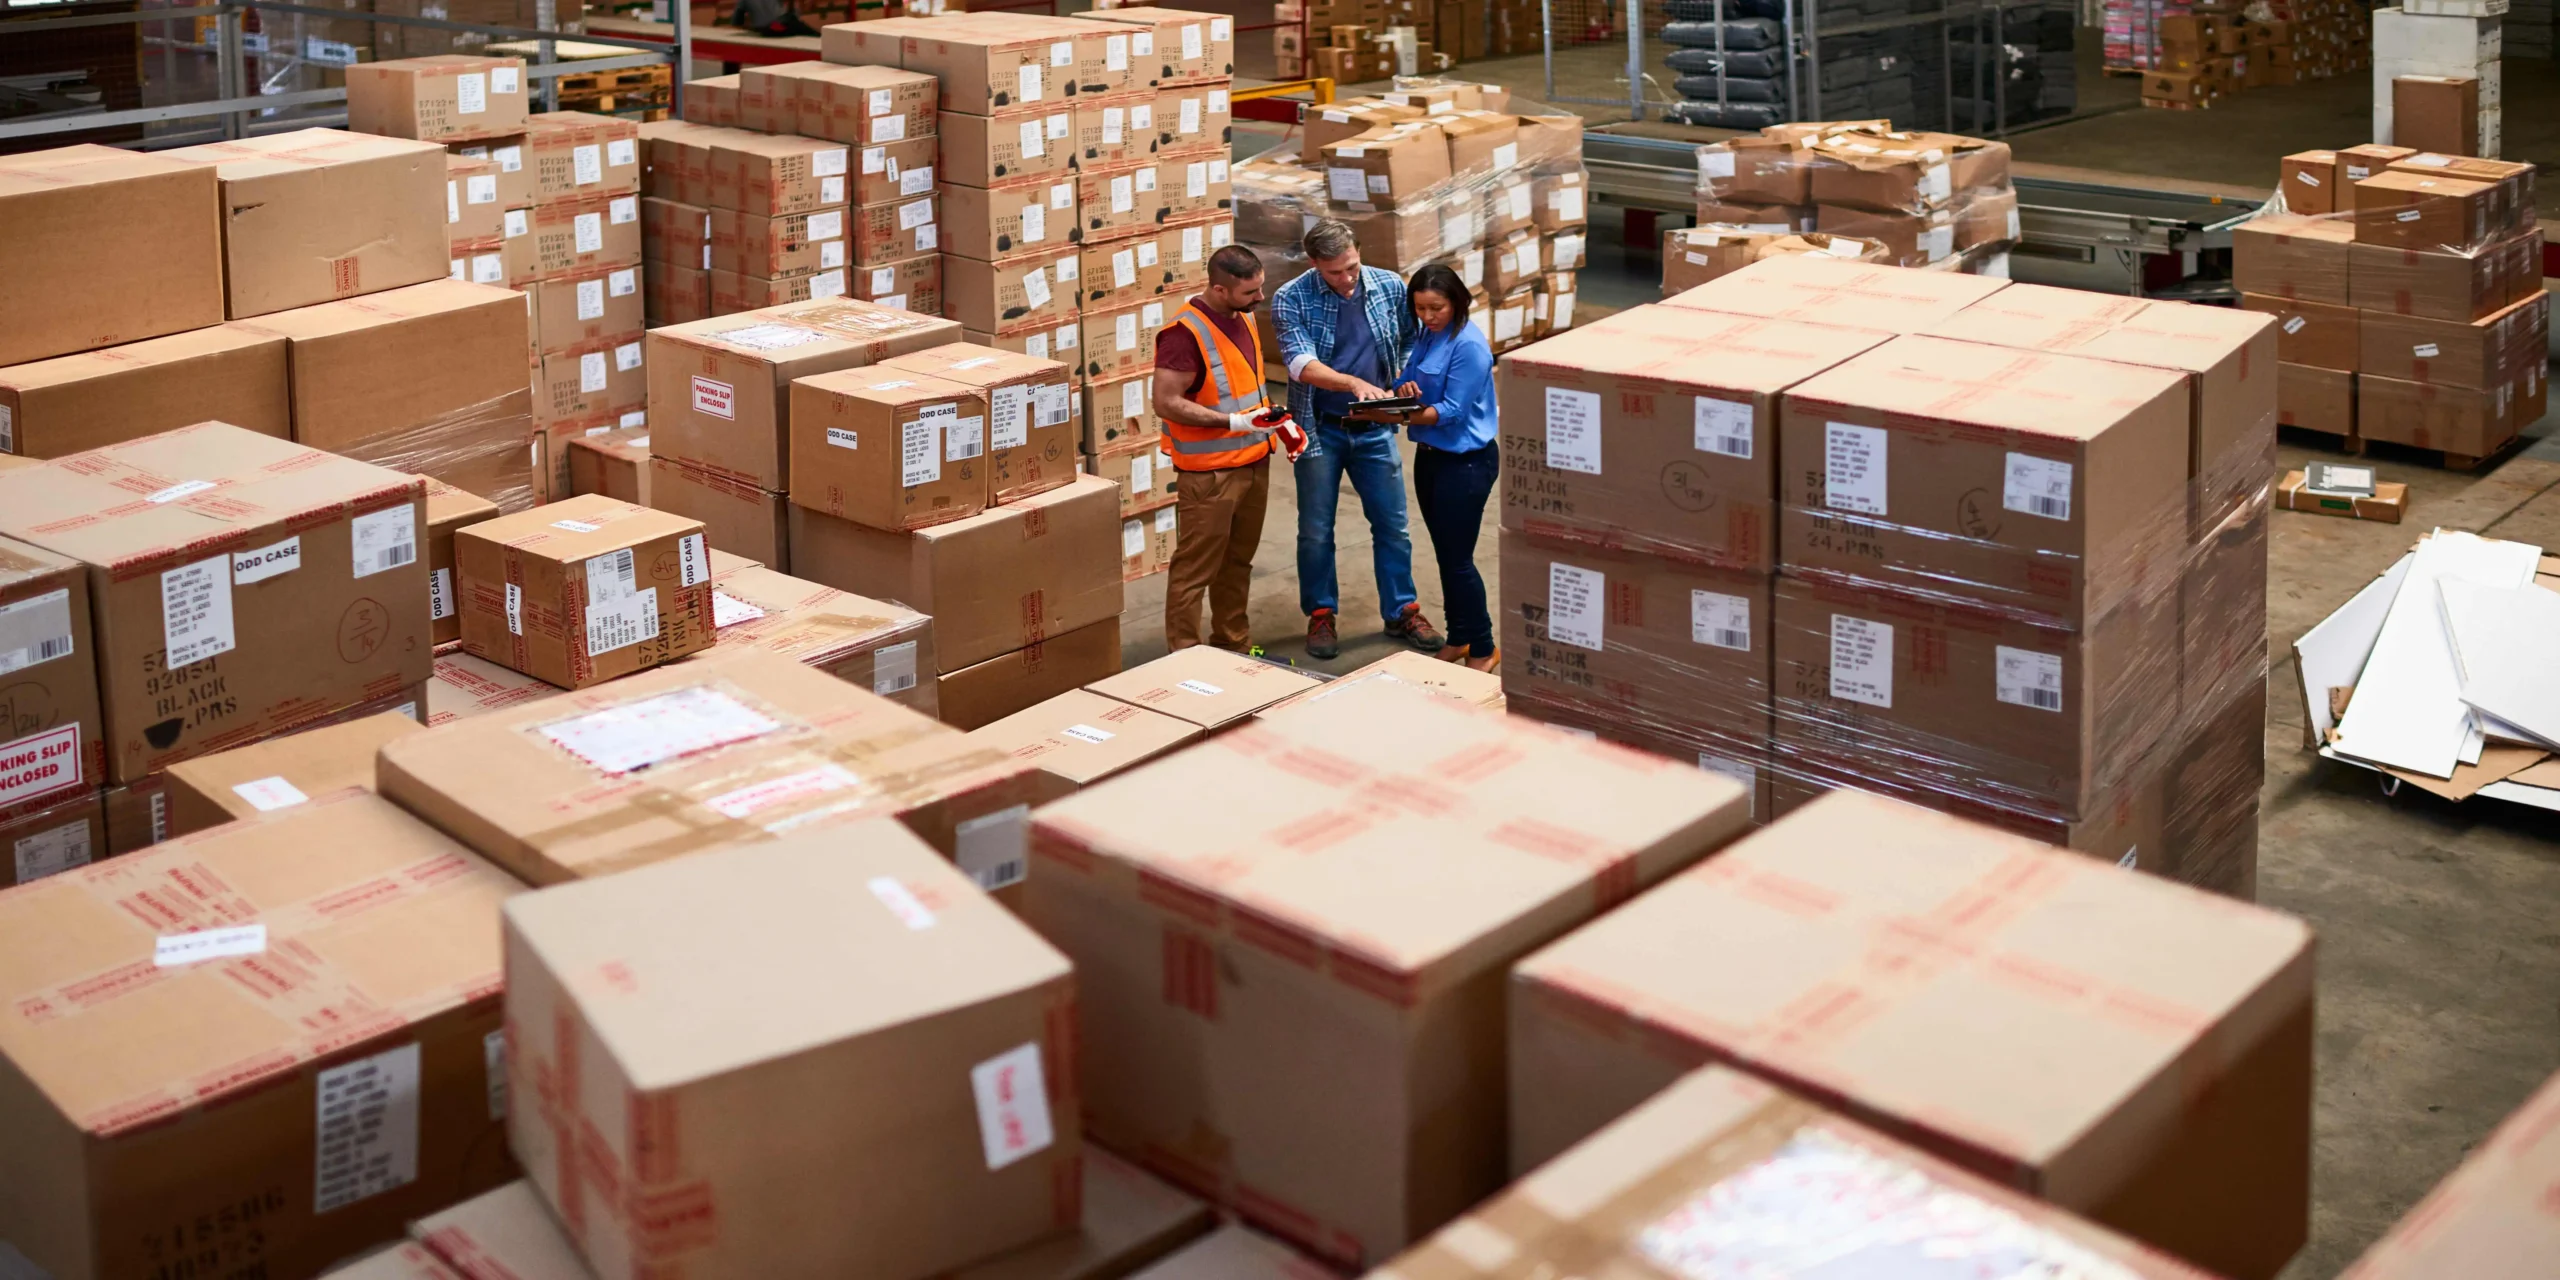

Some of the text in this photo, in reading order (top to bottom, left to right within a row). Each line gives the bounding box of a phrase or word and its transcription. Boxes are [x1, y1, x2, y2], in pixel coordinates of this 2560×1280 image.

[695, 384, 731, 400] PACKING SLIP
[700, 396, 727, 410] ENCLOSED
[920, 407, 956, 419] ODD CASE
[827, 429, 857, 442] ODD CASE
[1512, 475, 1567, 496] BLACK
[111, 483, 409, 571] WARNING WARNING WARNING WARNING
[235, 544, 299, 572] ODD CASE
[684, 537, 695, 584] ODD CASE
[430, 570, 443, 617] ODD CASE
[567, 581, 577, 628] WARNING
[705, 585, 716, 631] WARNING
[509, 613, 517, 632] ODD
[672, 619, 687, 650] INK
[571, 635, 583, 682] WARNING
[157, 676, 225, 717] BLACK
[0, 740, 71, 772] KING SLIP
[0, 765, 60, 790] NCLOSED
